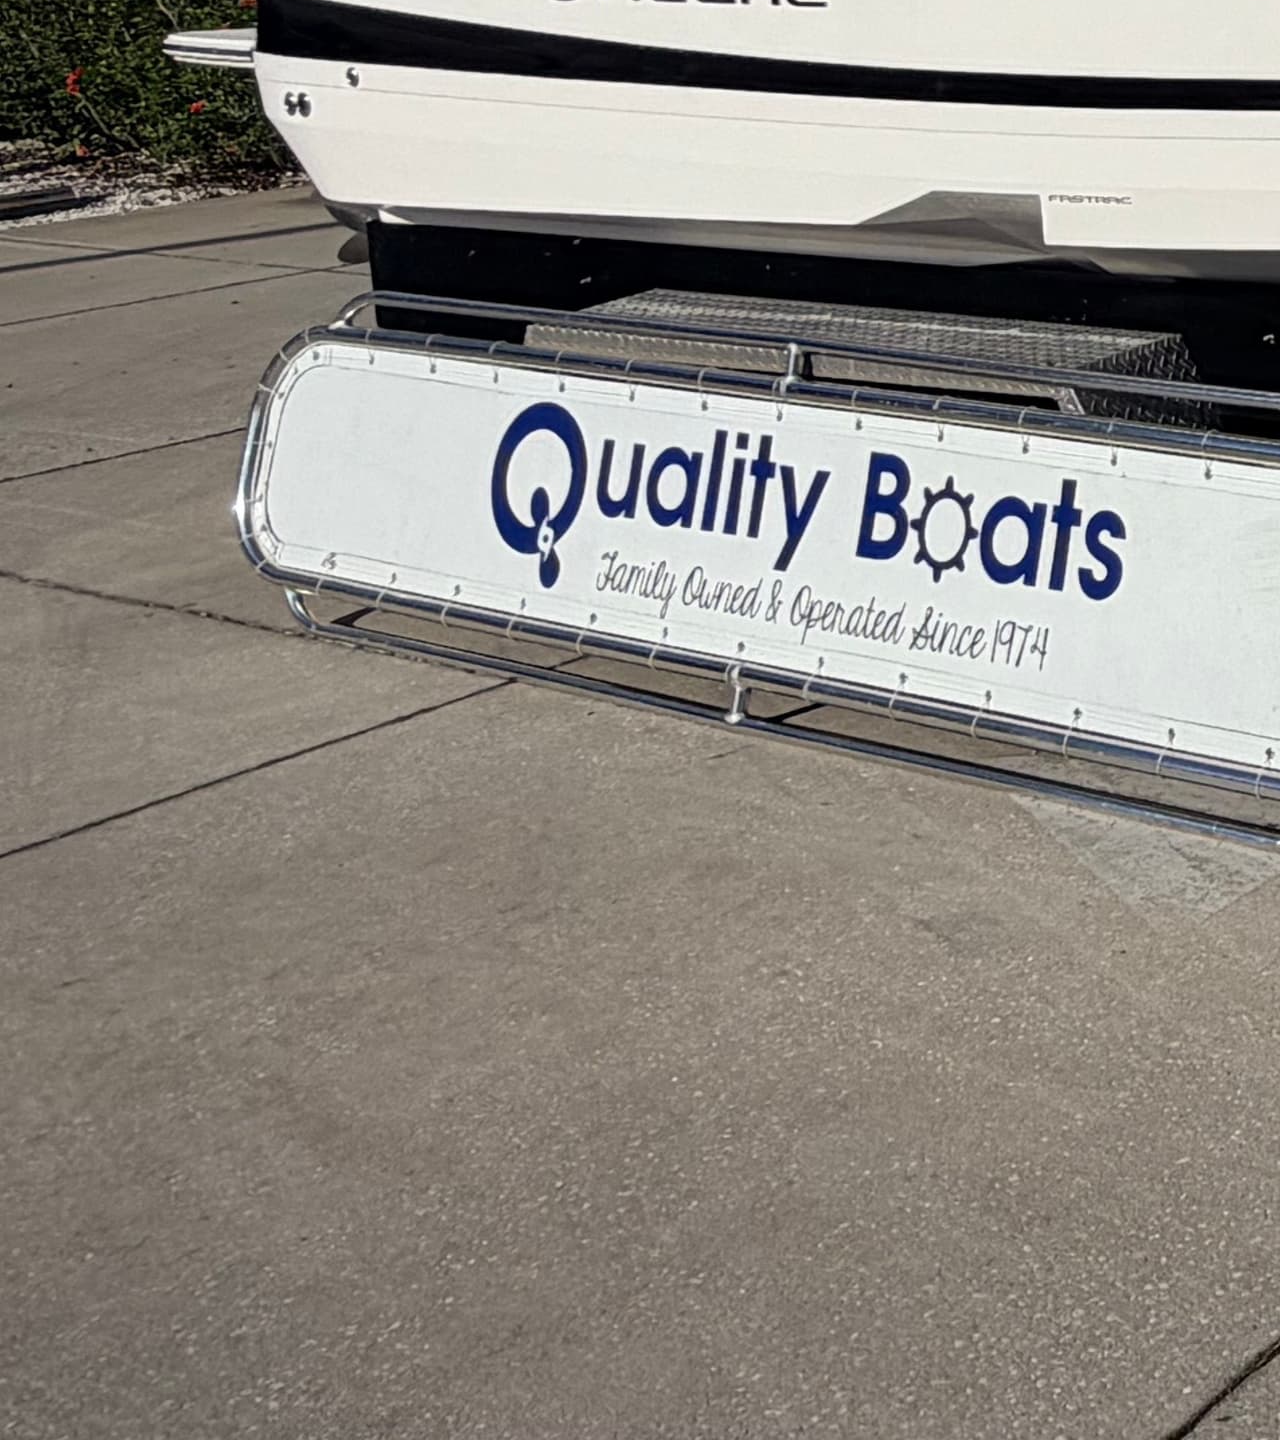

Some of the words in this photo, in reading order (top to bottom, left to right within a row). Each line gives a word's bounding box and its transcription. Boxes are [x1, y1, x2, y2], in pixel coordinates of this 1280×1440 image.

[1048, 194, 1133, 205] FASTRAC
[491, 402, 831, 588] Quality
[856, 451, 1127, 601] Boats
[596, 550, 676, 619] Family
[682, 566, 763, 618] Owned
[765, 579, 784, 624] &
[790, 585, 907, 645] Operated
[909, 606, 987, 659] Since
[991, 620, 1049, 670] 1974
